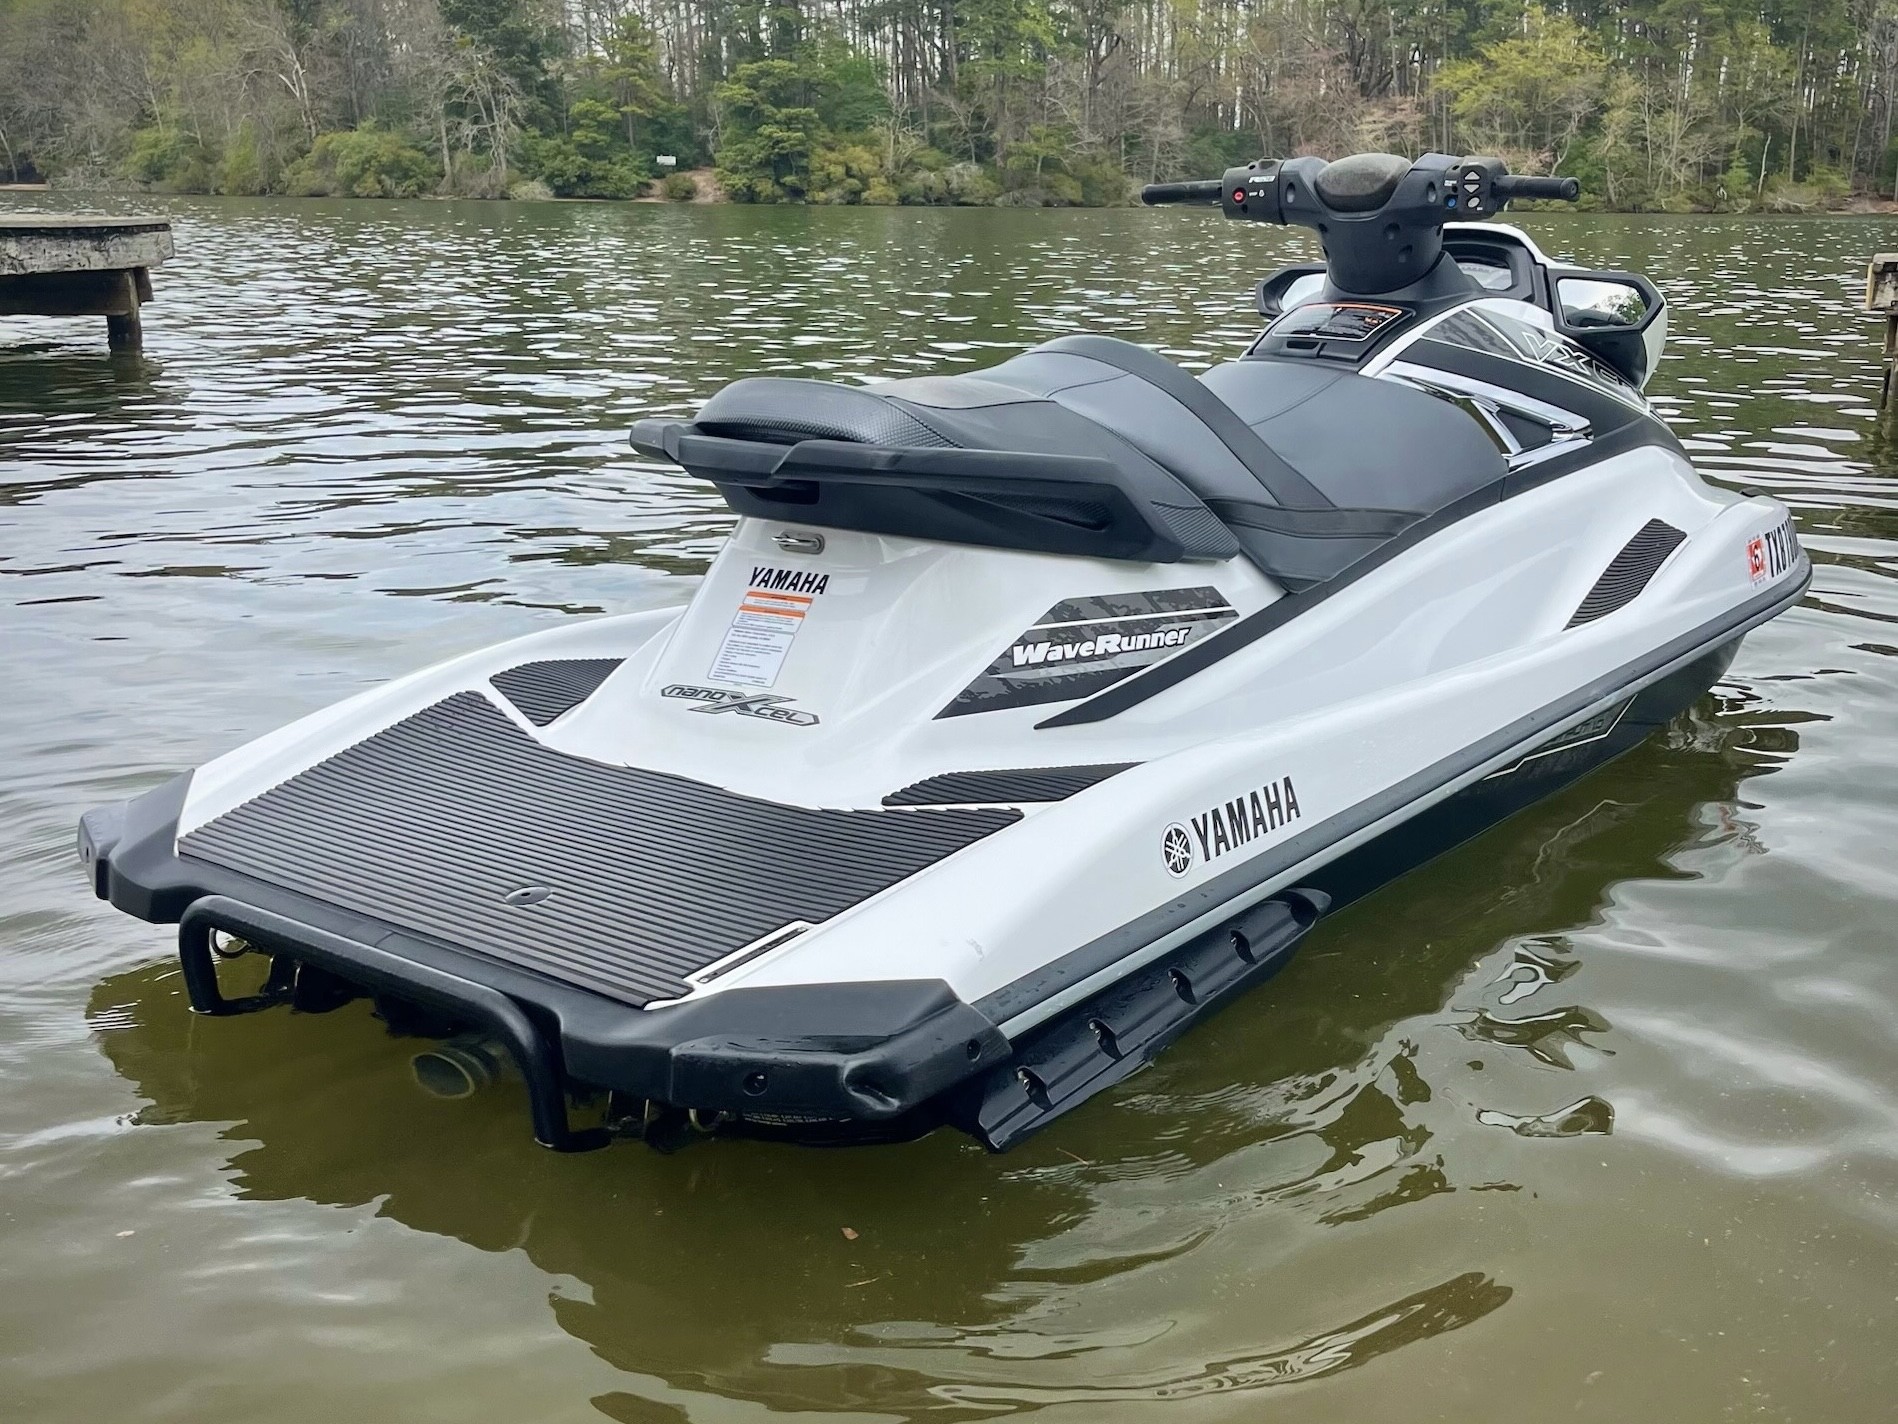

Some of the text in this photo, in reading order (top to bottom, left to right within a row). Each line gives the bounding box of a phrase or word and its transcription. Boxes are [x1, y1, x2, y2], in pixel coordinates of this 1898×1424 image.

[1521, 331, 1592, 375] VX
[748, 566, 830, 595] YAMAHA
[1011, 626, 1192, 666] WaveRunner
[1190, 775, 1301, 862] YAMAHA
